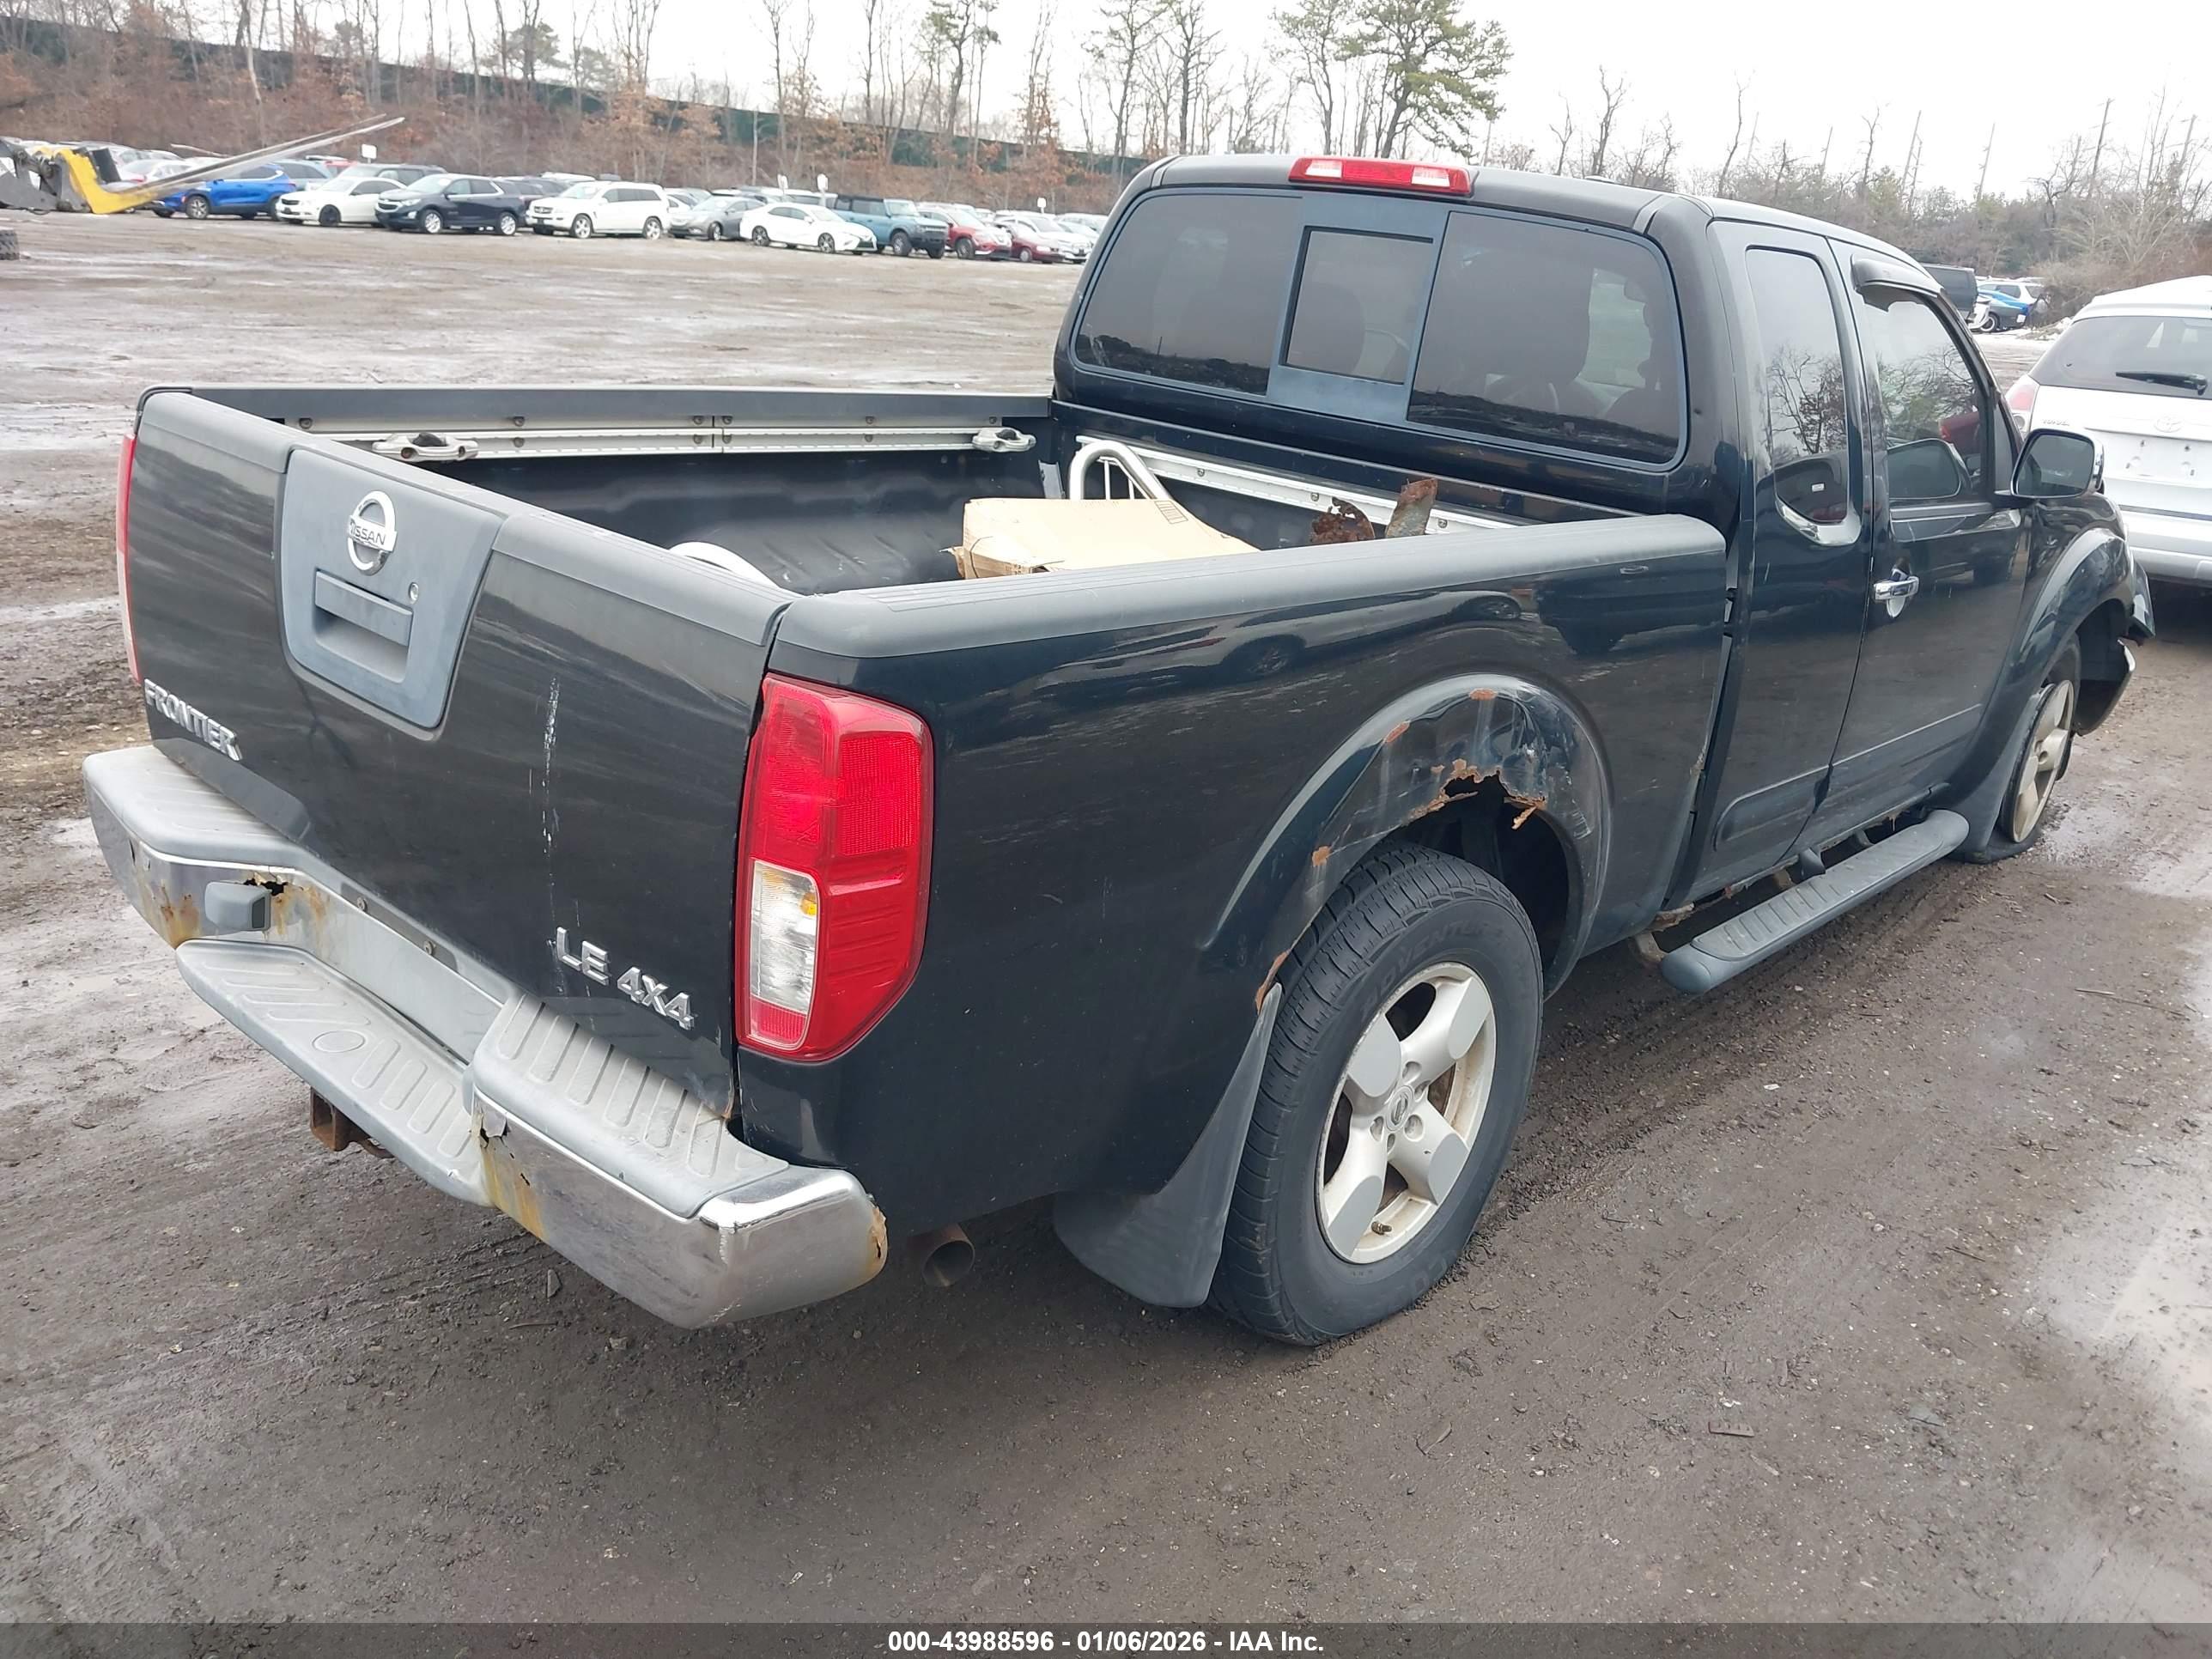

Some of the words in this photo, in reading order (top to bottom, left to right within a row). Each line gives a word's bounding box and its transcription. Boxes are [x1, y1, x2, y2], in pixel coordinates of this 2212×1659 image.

[349, 518, 386, 545] NISSAN
[144, 678, 242, 761] FRONTIER
[556, 927, 610, 987] LE
